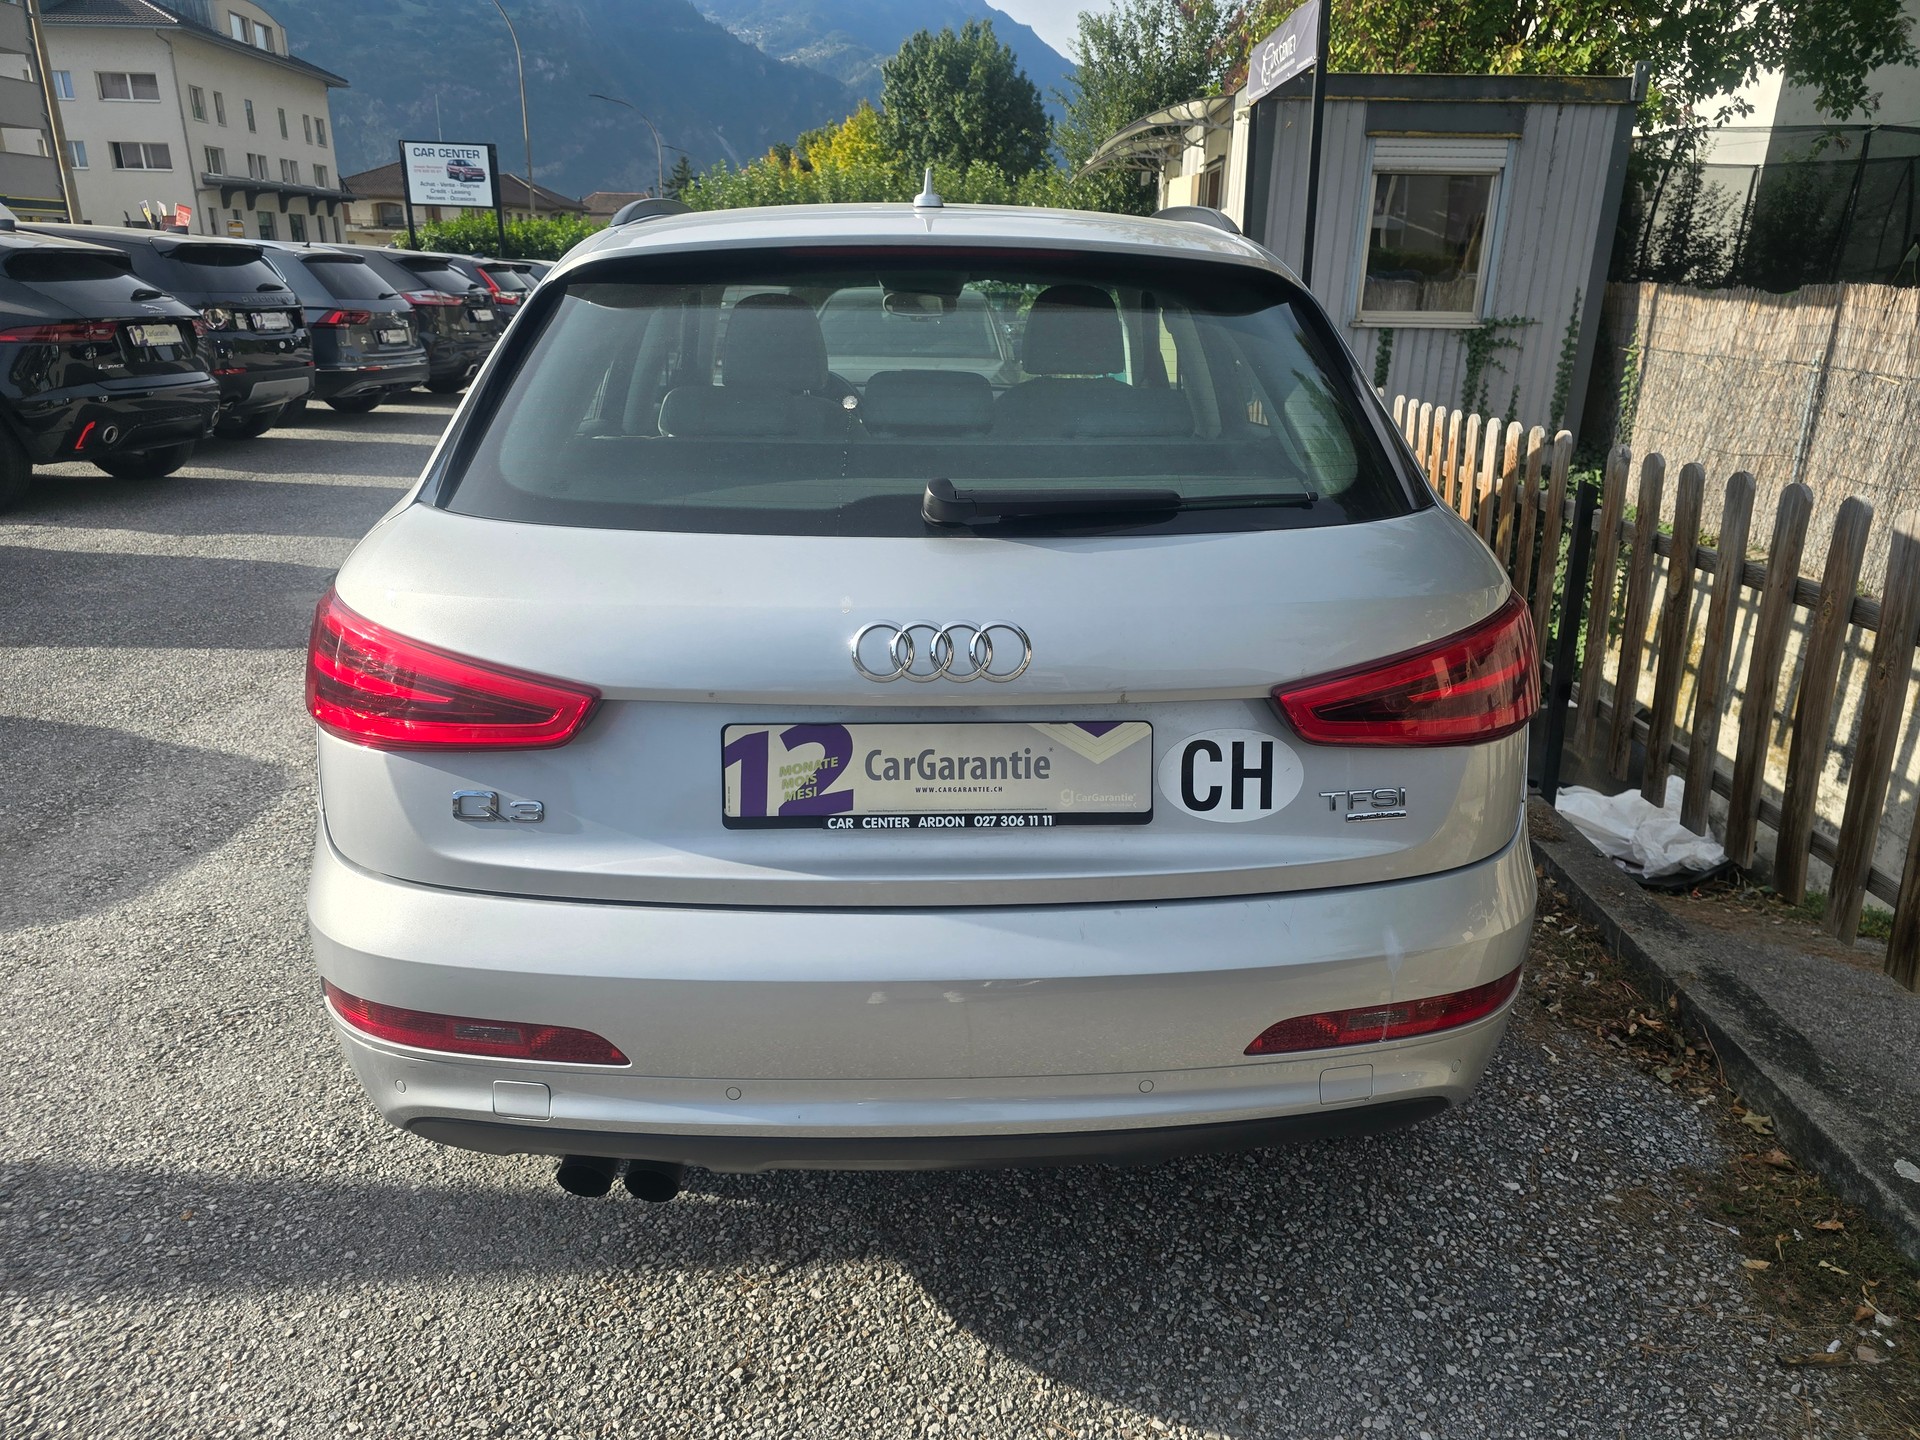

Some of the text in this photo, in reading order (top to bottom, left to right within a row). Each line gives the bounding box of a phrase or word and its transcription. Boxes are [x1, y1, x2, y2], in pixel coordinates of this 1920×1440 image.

[413, 147, 480, 159] CAR CENTER
[724, 724, 854, 817] 12
[779, 756, 839, 778] MONATE
[1181, 739, 1274, 812] CH
[781, 774, 818, 790] MOIS
[784, 786, 818, 802] MESI
[1319, 787, 1406, 811] TFSI
[452, 790, 545, 823] Q3
[827, 814, 1053, 829] CAR CENTER ARDON 027 306 11 11
